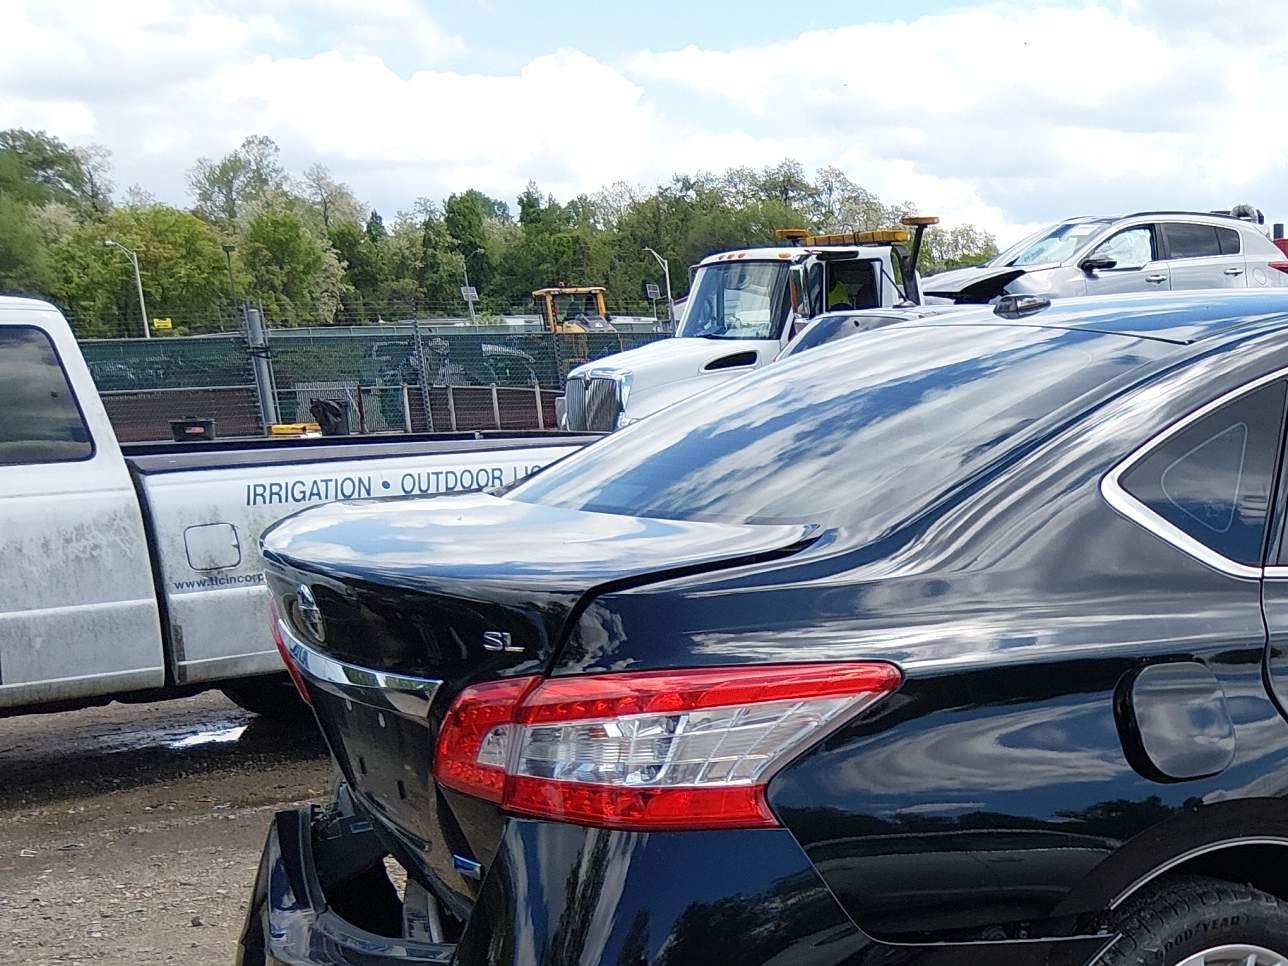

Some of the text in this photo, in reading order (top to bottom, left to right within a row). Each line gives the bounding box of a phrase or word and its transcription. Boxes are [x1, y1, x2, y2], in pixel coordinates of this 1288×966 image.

[246, 476, 372, 505] IRRIGATION
[401, 467, 504, 494] OUTDOOR
[483, 631, 526, 652] SL
